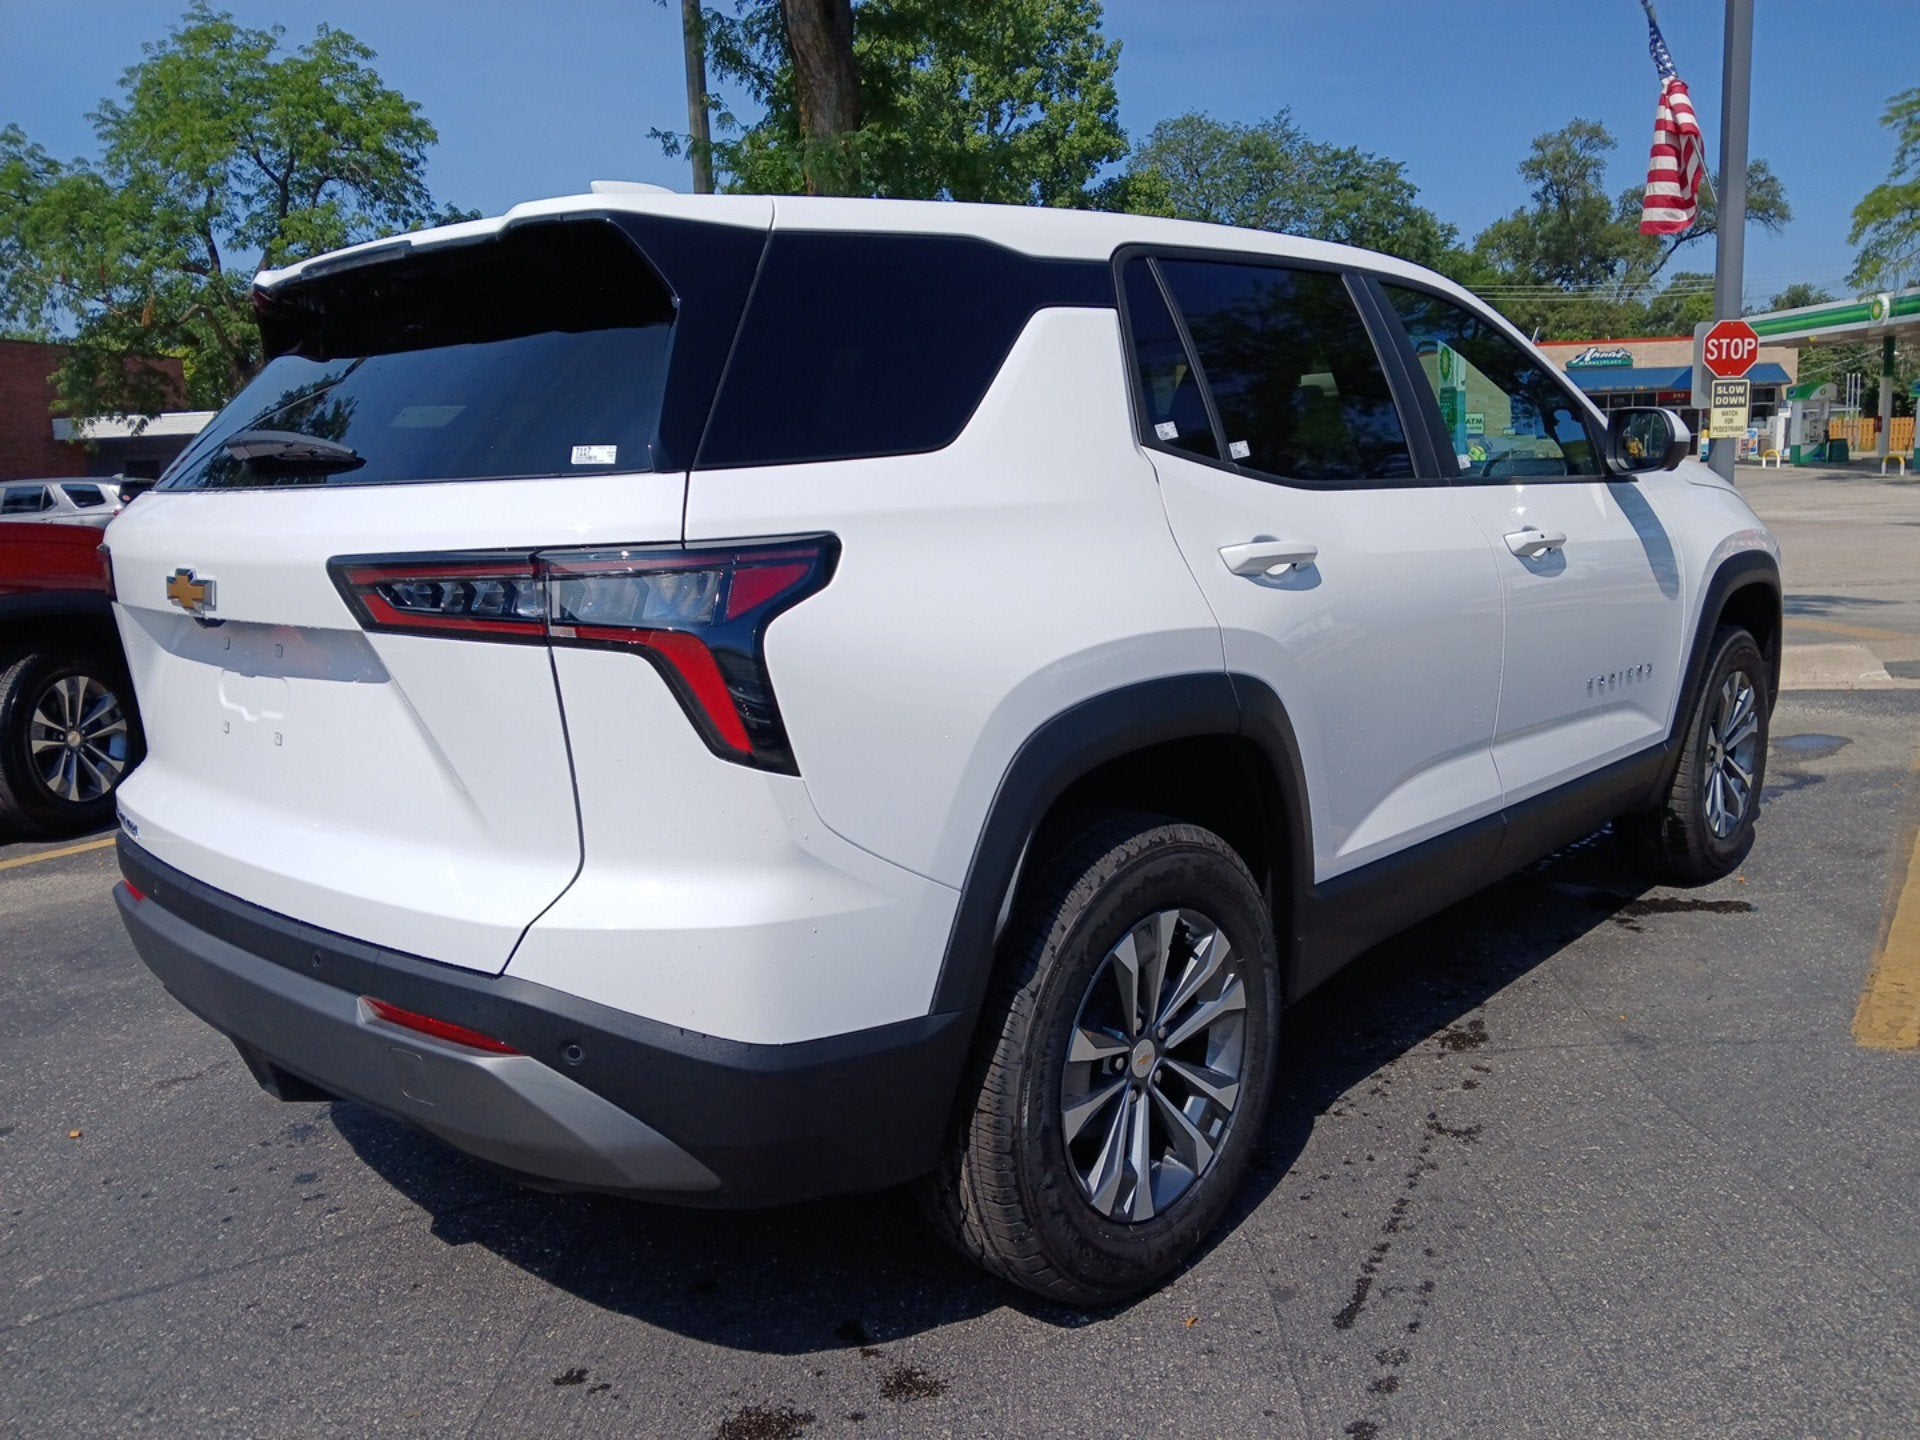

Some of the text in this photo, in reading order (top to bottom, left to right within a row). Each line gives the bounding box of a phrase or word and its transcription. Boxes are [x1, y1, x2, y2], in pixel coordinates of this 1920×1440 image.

[1706, 338, 1756, 360] STOP
[1716, 385, 1746, 395] SLOW
[1715, 396, 1746, 405] DOWN
